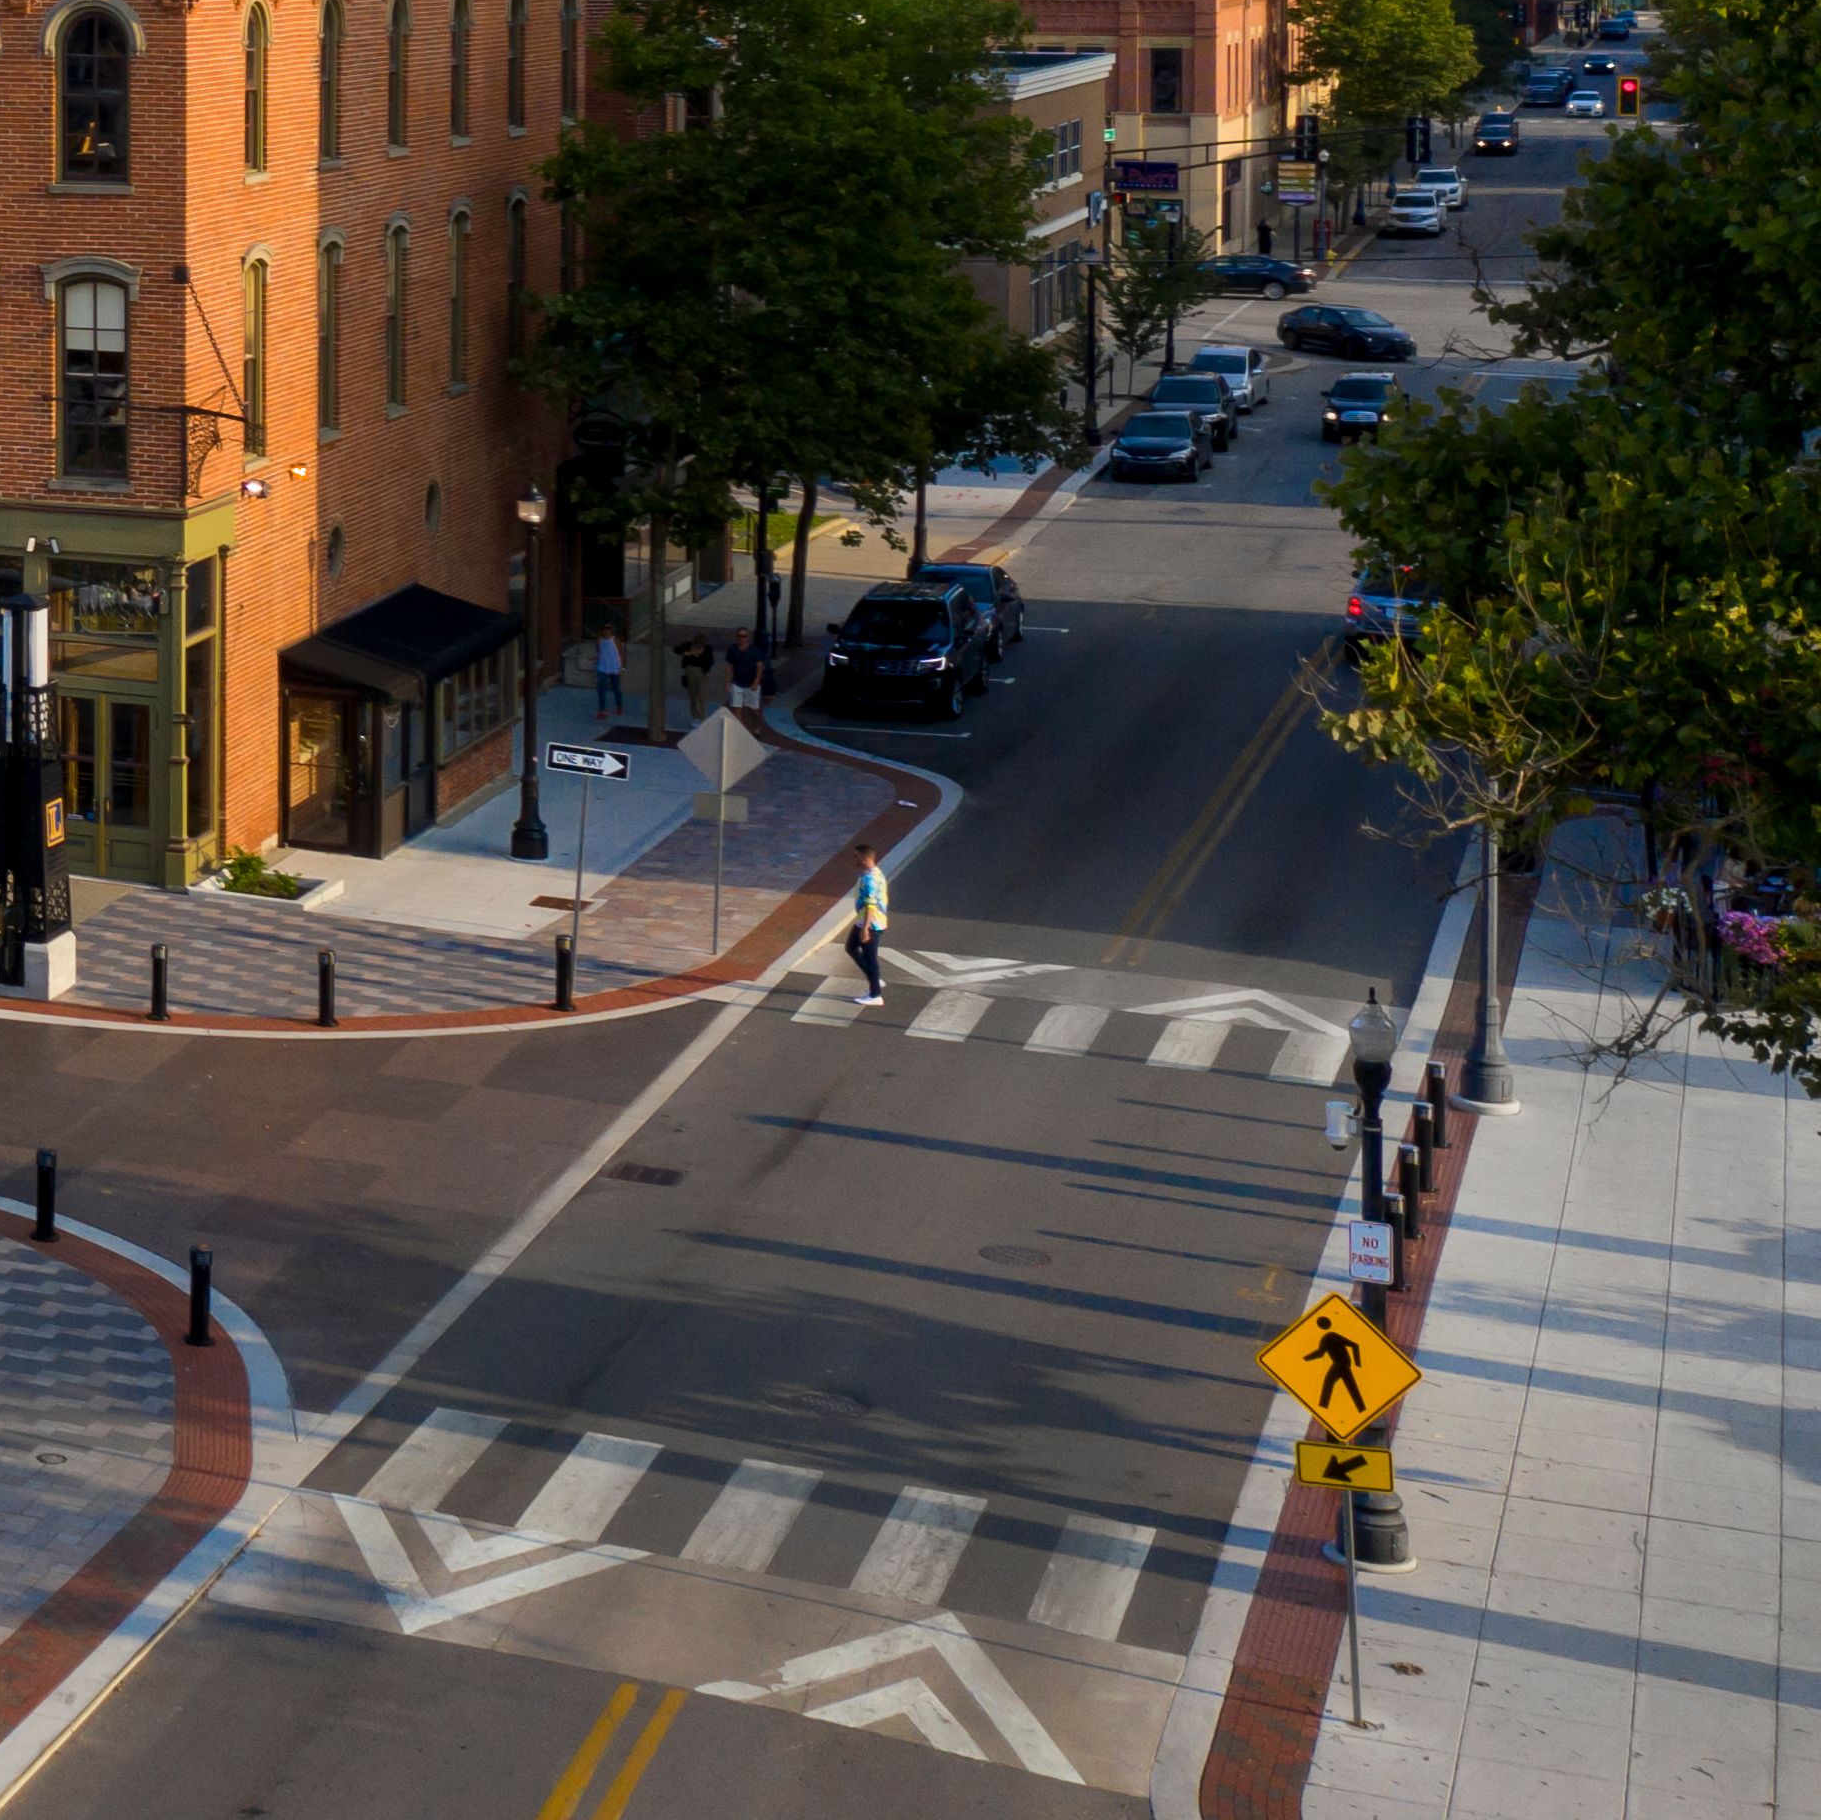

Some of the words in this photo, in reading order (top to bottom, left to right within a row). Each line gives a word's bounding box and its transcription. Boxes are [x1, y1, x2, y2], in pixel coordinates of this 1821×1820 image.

[556, 752, 578, 765] ONE
[582, 756, 604, 768] WAY
[1362, 1236, 1379, 1249] NO
[1351, 1252, 1390, 1268] PARKING
